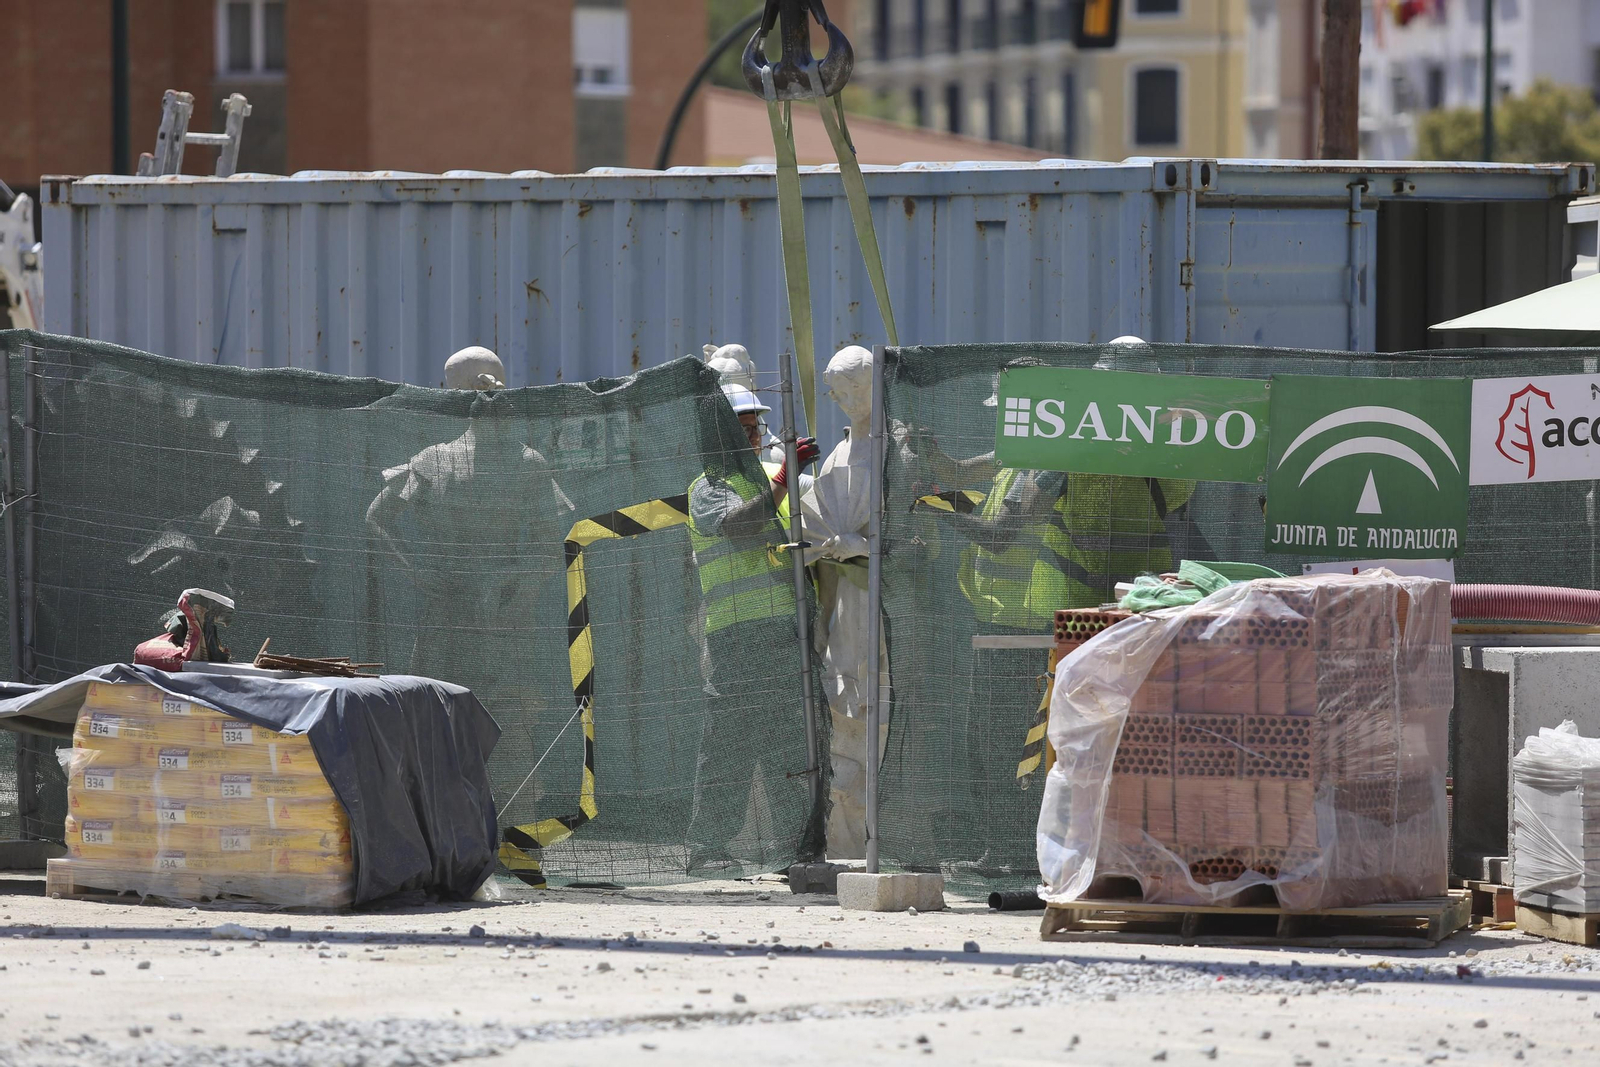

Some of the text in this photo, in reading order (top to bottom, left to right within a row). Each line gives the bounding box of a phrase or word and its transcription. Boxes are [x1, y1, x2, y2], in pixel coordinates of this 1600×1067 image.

[1033, 399, 1256, 450] SANDO
[1271, 524, 1458, 549] JUNTA DE ANDALUCIA
[164, 702, 182, 714] 334
[92, 722, 109, 735] 334
[225, 731, 243, 742] 334
[161, 757, 179, 768] 334
[86, 777, 105, 788] 334
[223, 784, 242, 796] 334
[84, 832, 103, 843] 334
